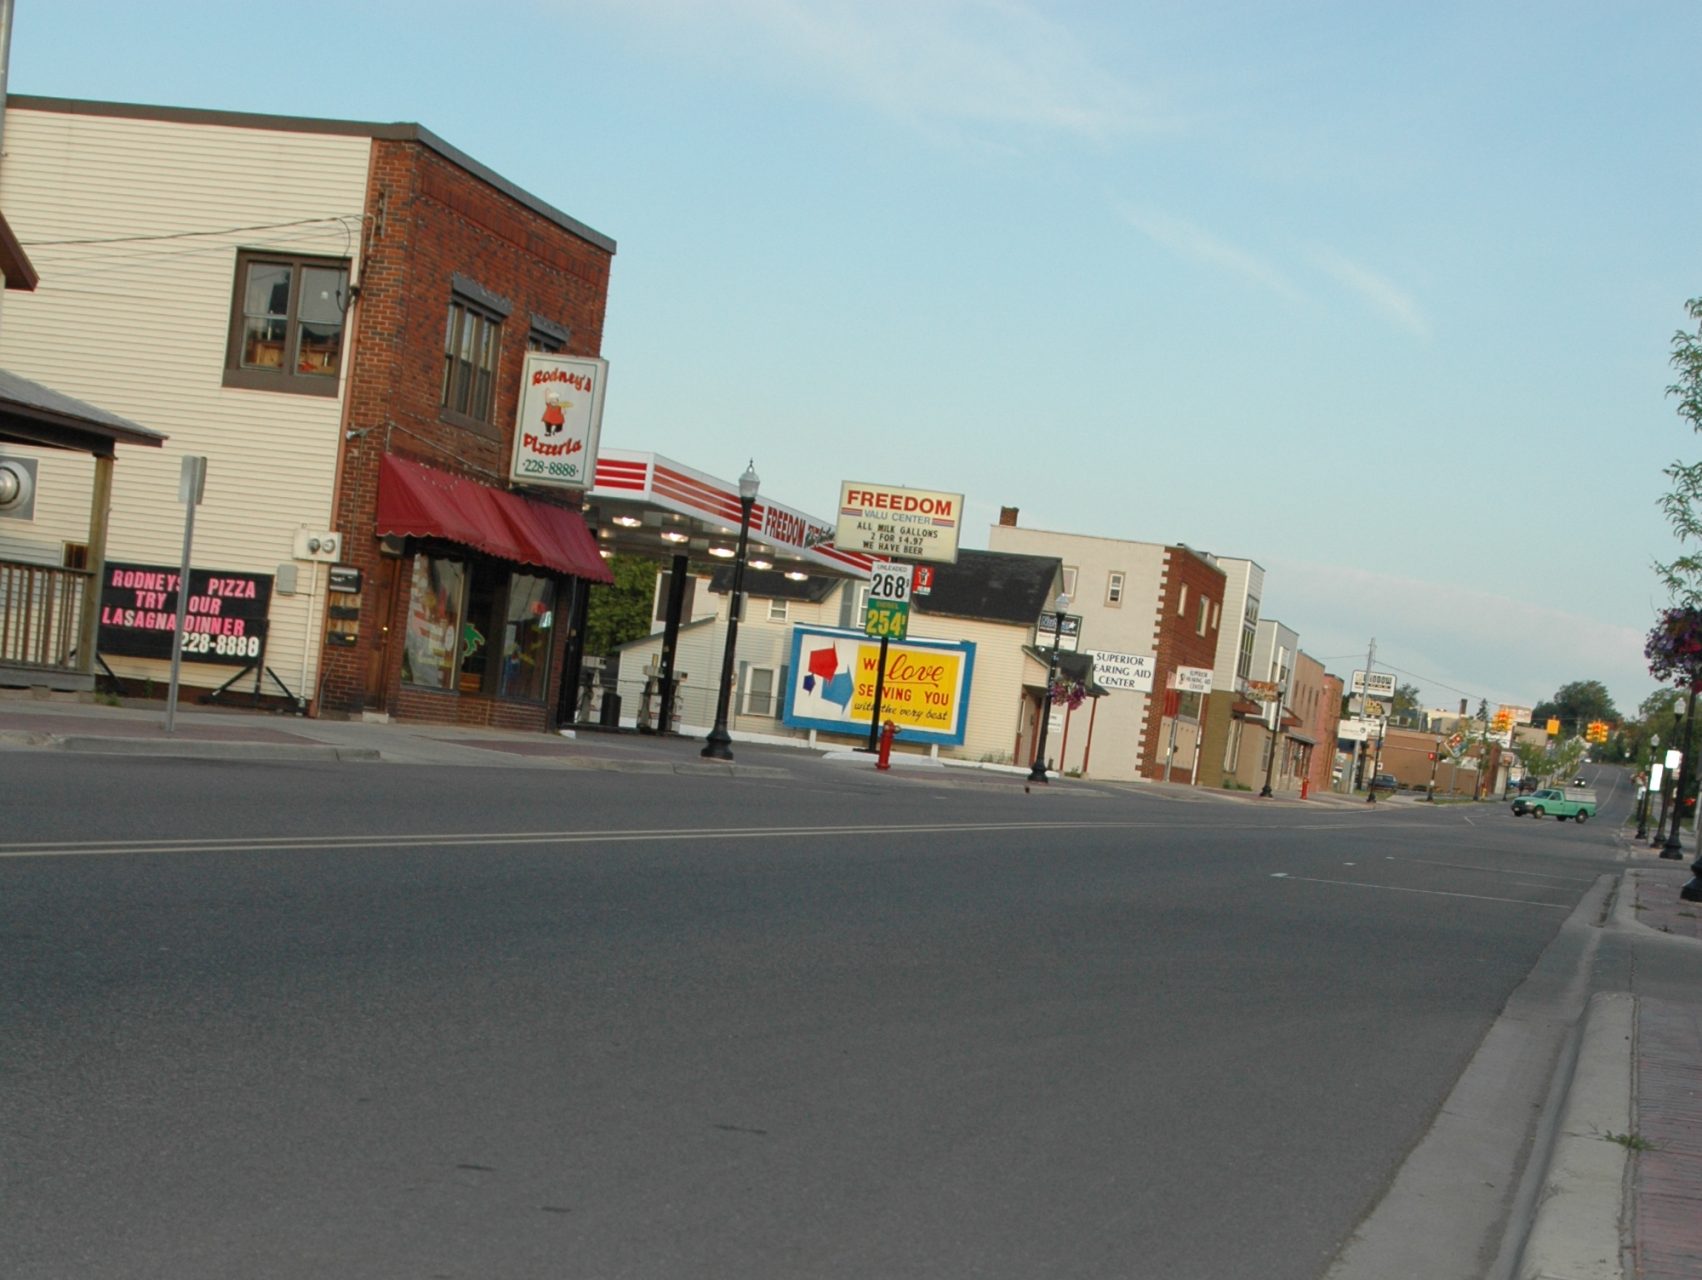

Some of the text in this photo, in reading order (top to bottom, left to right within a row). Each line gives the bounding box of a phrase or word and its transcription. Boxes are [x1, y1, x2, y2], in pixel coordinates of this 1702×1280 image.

[532, 368, 592, 392] Rodney's
[523, 432, 582, 456] Pizzeria
[524, 459, 577, 477] 228-8888
[848, 489, 953, 516] FREEDOM
[765, 506, 806, 548] FREEDOM
[864, 509, 931, 525] VALU CENTER
[857, 521, 938, 539] ALL MILK GALLONS
[880, 533, 895, 542] FOR
[899, 536, 923, 545] $4.97
[863, 541, 923, 555] WE HAVE BEER
[207, 578, 256, 598] PIZZA
[871, 572, 905, 598] 268
[136, 590, 222, 615] TRY OUR
[102, 608, 245, 636] LASAGNA DINNER
[866, 609, 901, 637] 254
[181, 631, 259, 657] 228-8888
[863, 653, 945, 682] W love
[1093, 663, 1152, 679] EARING AID
[1096, 652, 1144, 666] SUPERIOR
[1098, 675, 1135, 688] CENTER
[858, 682, 949, 706] SEVING YOU
